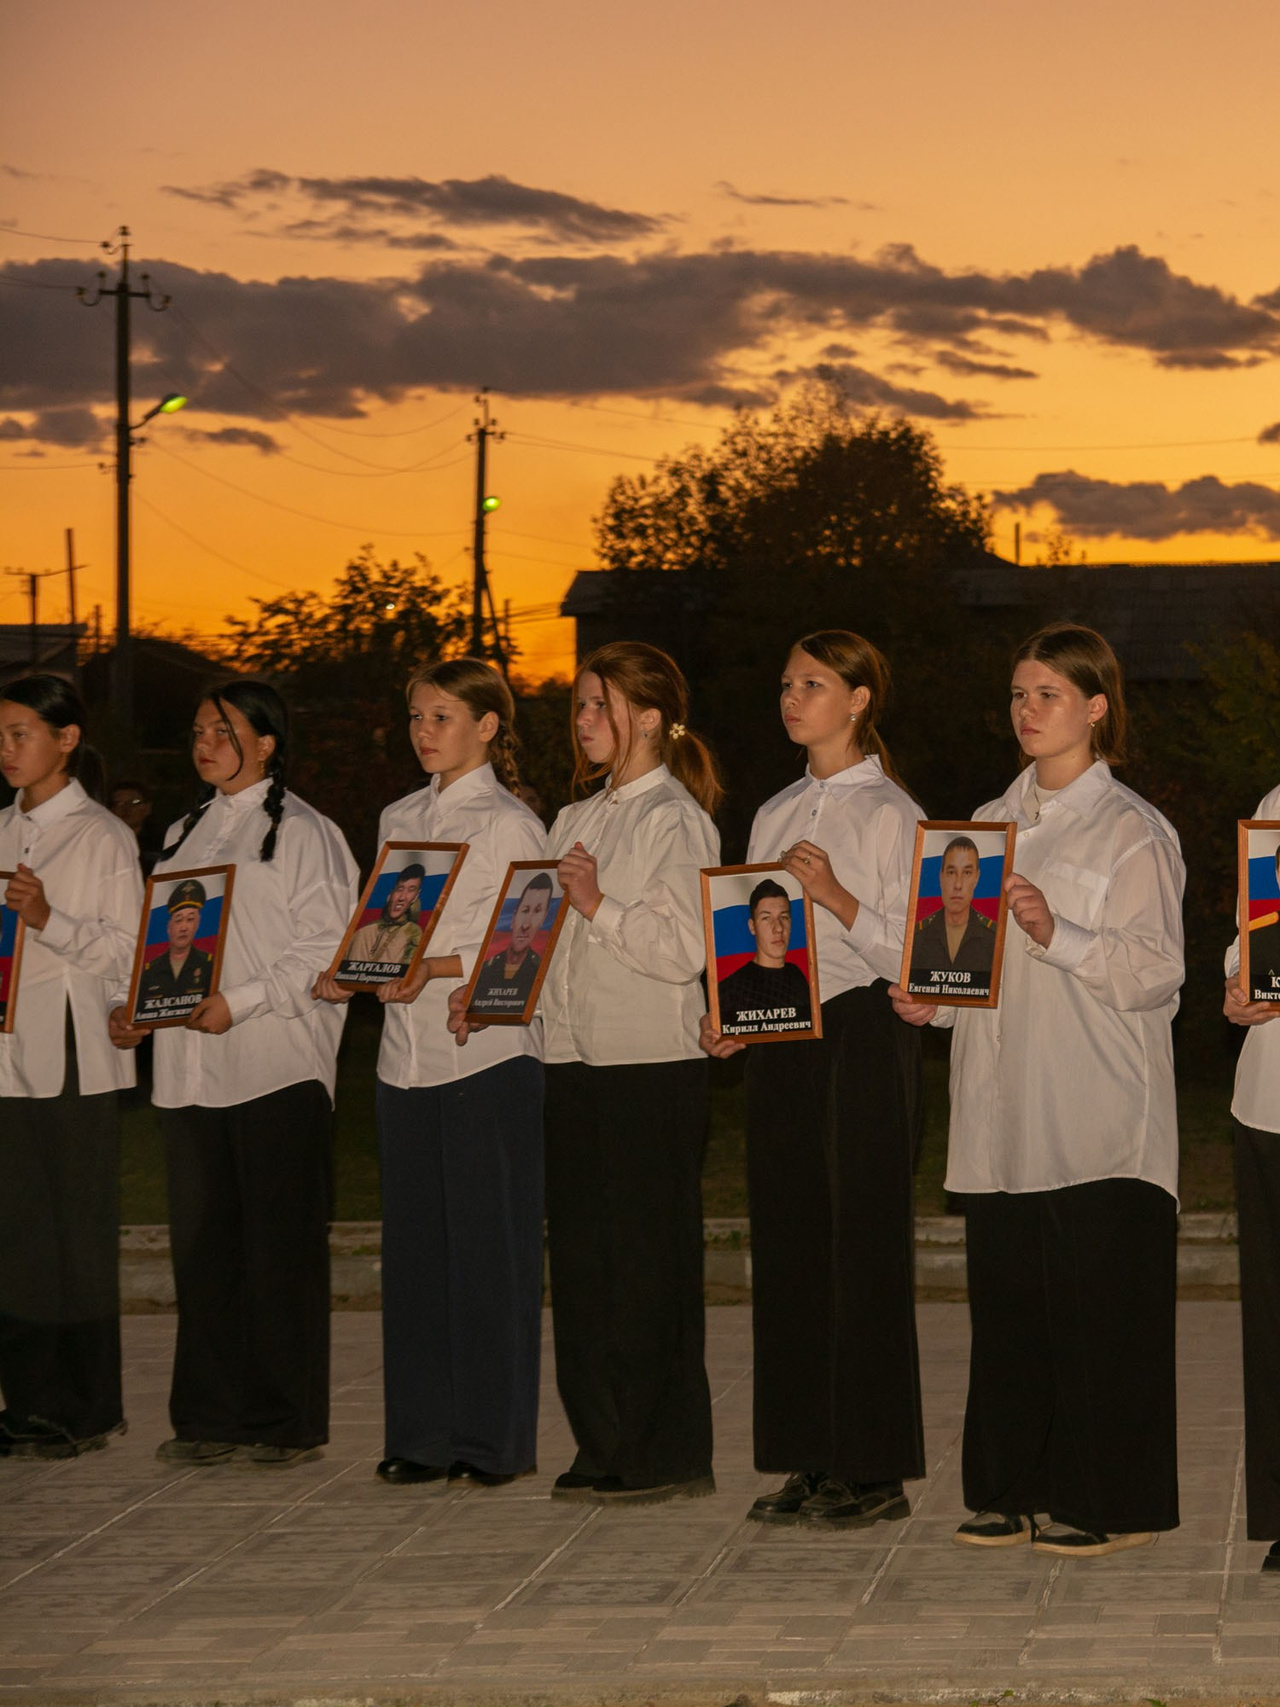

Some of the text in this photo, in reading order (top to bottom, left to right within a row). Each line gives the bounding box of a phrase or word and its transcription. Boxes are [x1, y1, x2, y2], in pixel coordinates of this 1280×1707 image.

[348, 962, 401, 974] ЖАРГАЛОВ
[930, 970, 971, 983] ЖУКОВ
[908, 983, 989, 996] Евгений Николаевич
[736, 1007, 797, 1021] ЖИХАРЕВ
[722, 1021, 811, 1035] Кирилл Андреевич
